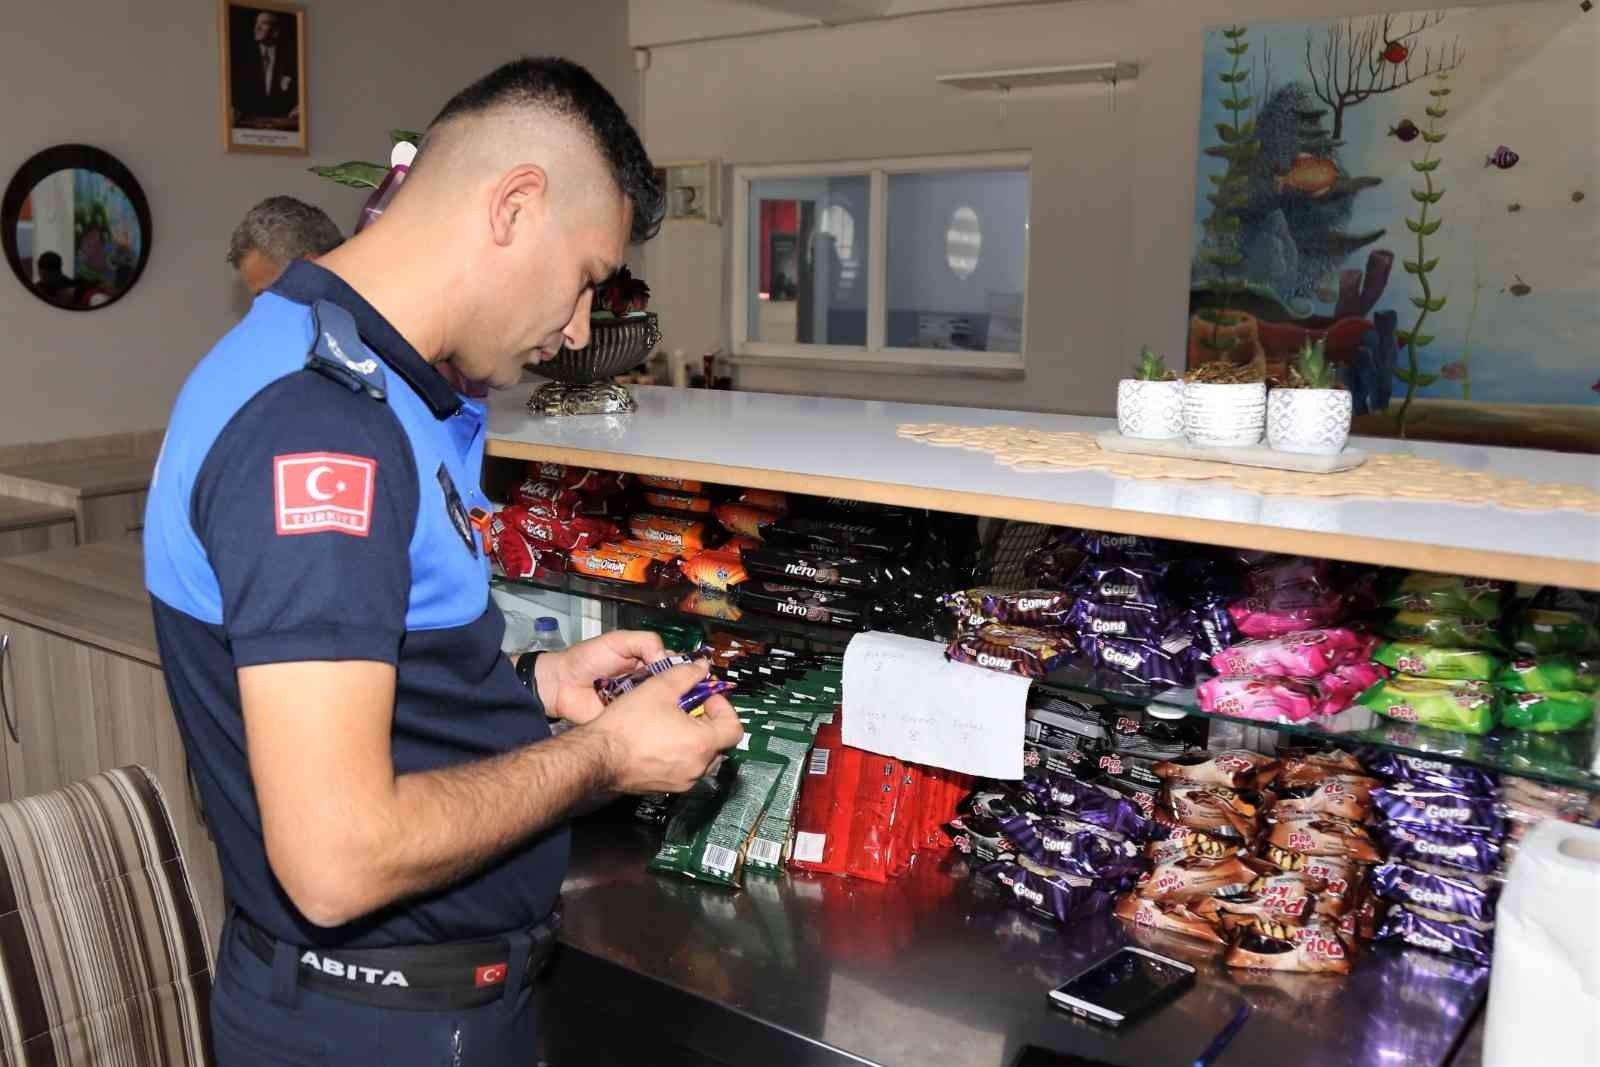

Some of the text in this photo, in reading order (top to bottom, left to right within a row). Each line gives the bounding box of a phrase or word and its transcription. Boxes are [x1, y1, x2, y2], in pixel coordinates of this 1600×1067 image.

[784, 563, 817, 577] nero
[1101, 581, 1139, 599] Gong
[777, 602, 807, 616] nero
[1017, 597, 1054, 613] Gong
[1091, 618, 1127, 634] Gong
[976, 652, 1013, 670] Gong
[1102, 648, 1142, 671] Gong
[1408, 756, 1453, 772] Gong
[1424, 803, 1472, 822] Gong
[1042, 836, 1073, 855] Gong
[1414, 838, 1459, 859] Gong
[1013, 882, 1045, 905] Gong
[1409, 887, 1455, 907] Gong
[1263, 895, 1308, 915] Pop
[1412, 932, 1454, 952] Gong
